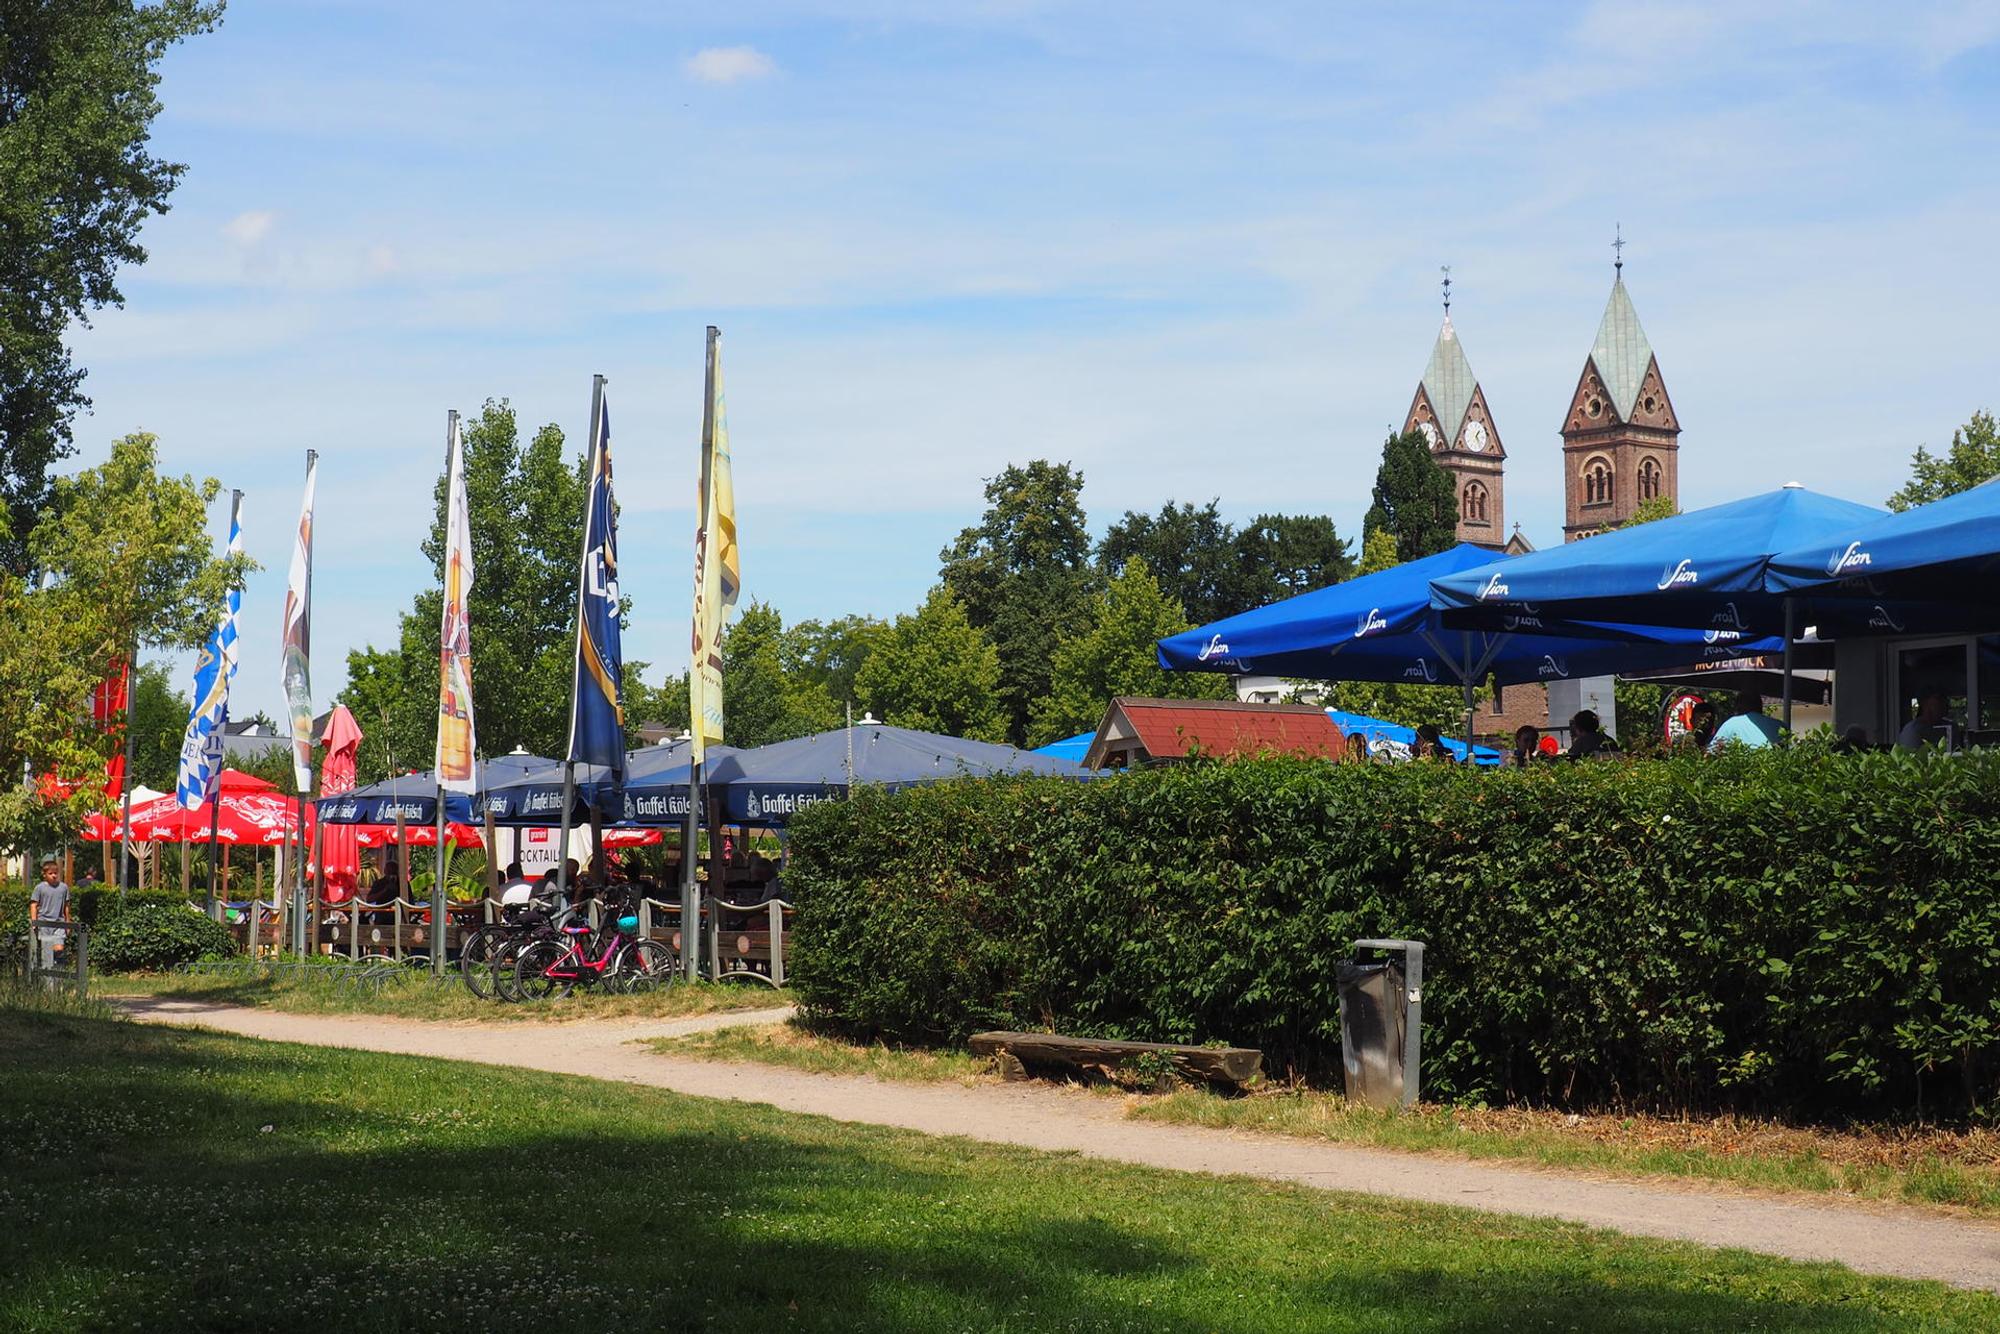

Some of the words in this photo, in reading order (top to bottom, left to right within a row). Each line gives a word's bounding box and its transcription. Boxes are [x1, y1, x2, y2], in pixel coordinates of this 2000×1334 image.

[1825, 541, 1873, 577] Sion
[1476, 573, 1509, 602] Sion
[1657, 559, 1697, 590] Sion
[1354, 608, 1387, 637] Sion
[1197, 634, 1229, 661] Sion
[636, 796, 668, 816] Gaffel
[669, 796, 704, 817] Kölsh
[762, 793, 796, 815] Gaffel
[192, 826, 238, 841] Aludler
[520, 849, 561, 863] OCKTAIL
